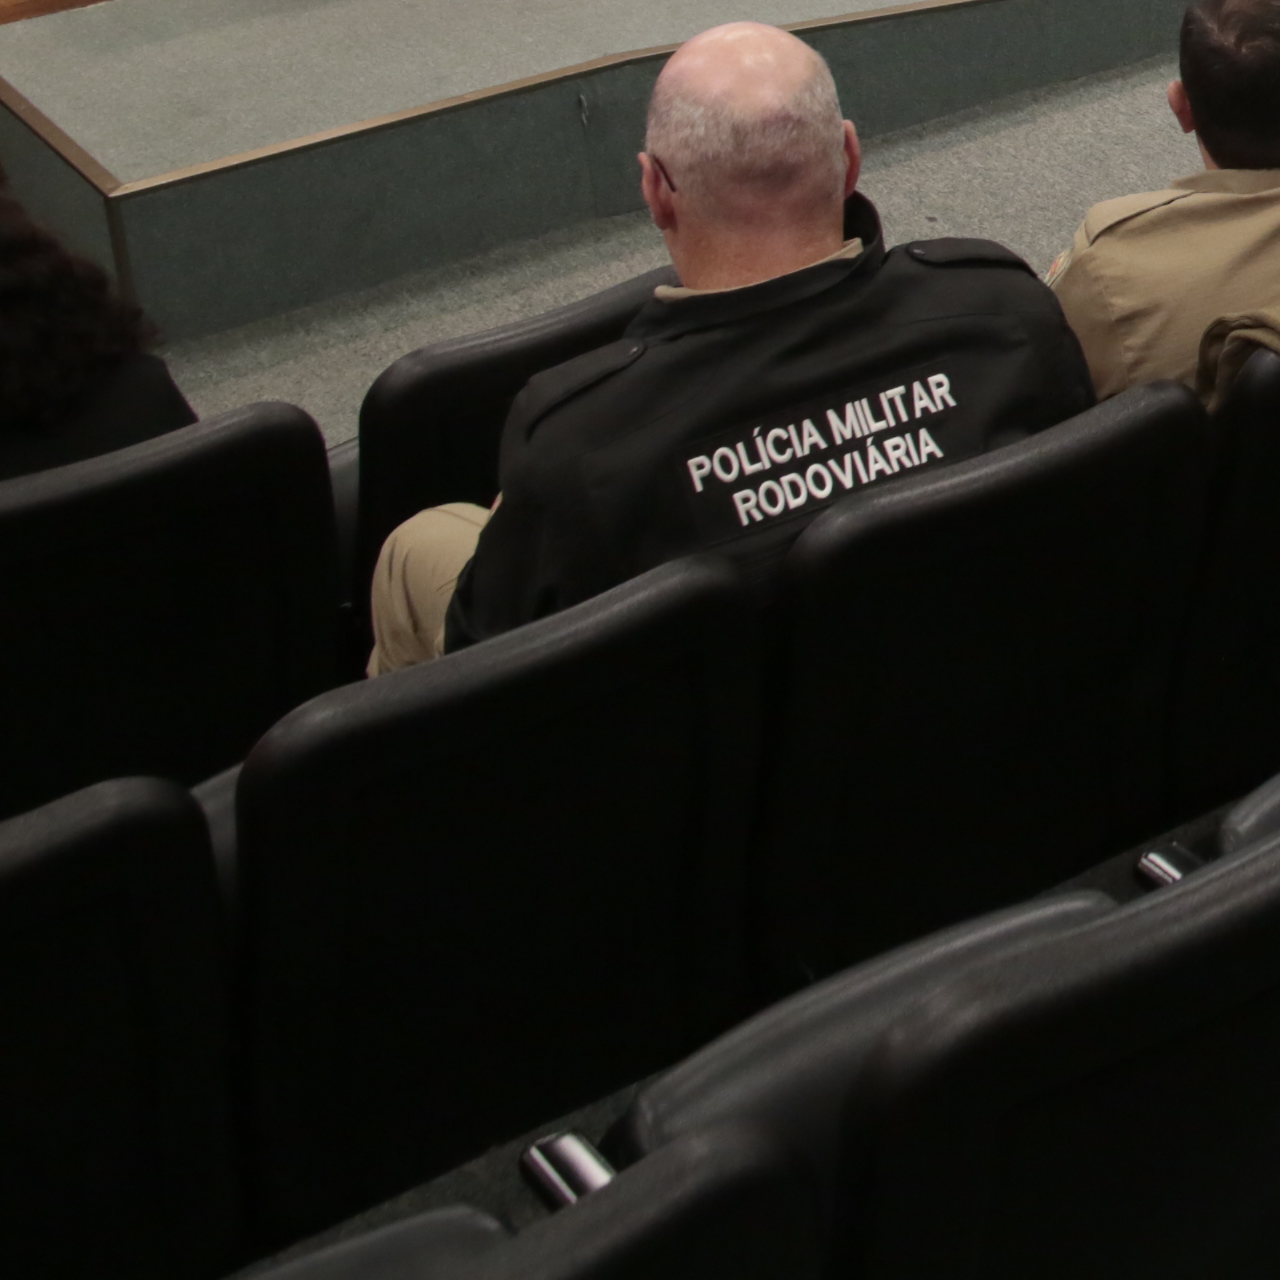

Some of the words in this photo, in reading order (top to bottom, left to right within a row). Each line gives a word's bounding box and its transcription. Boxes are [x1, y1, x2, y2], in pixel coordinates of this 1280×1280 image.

[687, 418, 828, 493] POLÍCIA
[826, 372, 957, 446] MILITAR
[733, 428, 944, 526] RODOVIÁRIA
